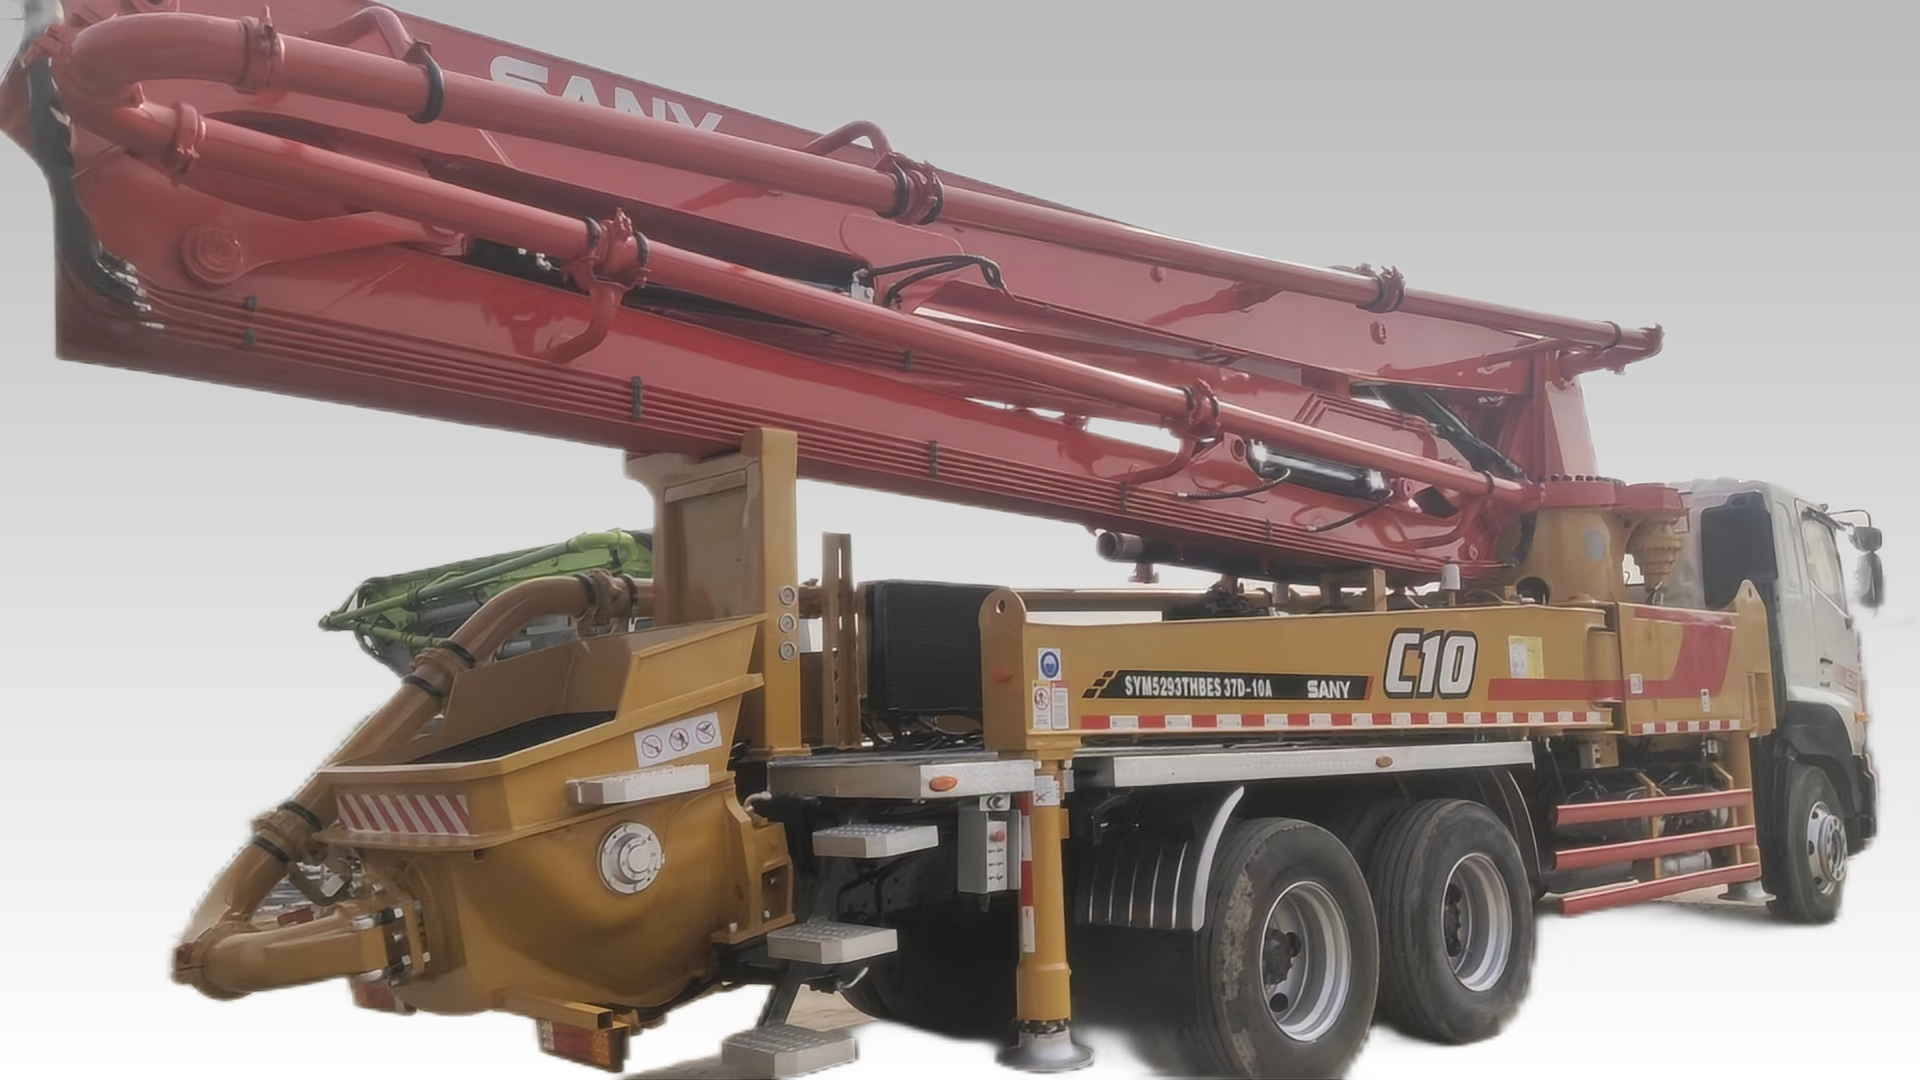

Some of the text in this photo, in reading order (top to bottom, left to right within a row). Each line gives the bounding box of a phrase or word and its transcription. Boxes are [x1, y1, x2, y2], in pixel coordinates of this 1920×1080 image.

[1125, 675, 1350, 699] SYM5293THBES 37D-10A SANY
[1384, 628, 1478, 699] C10
